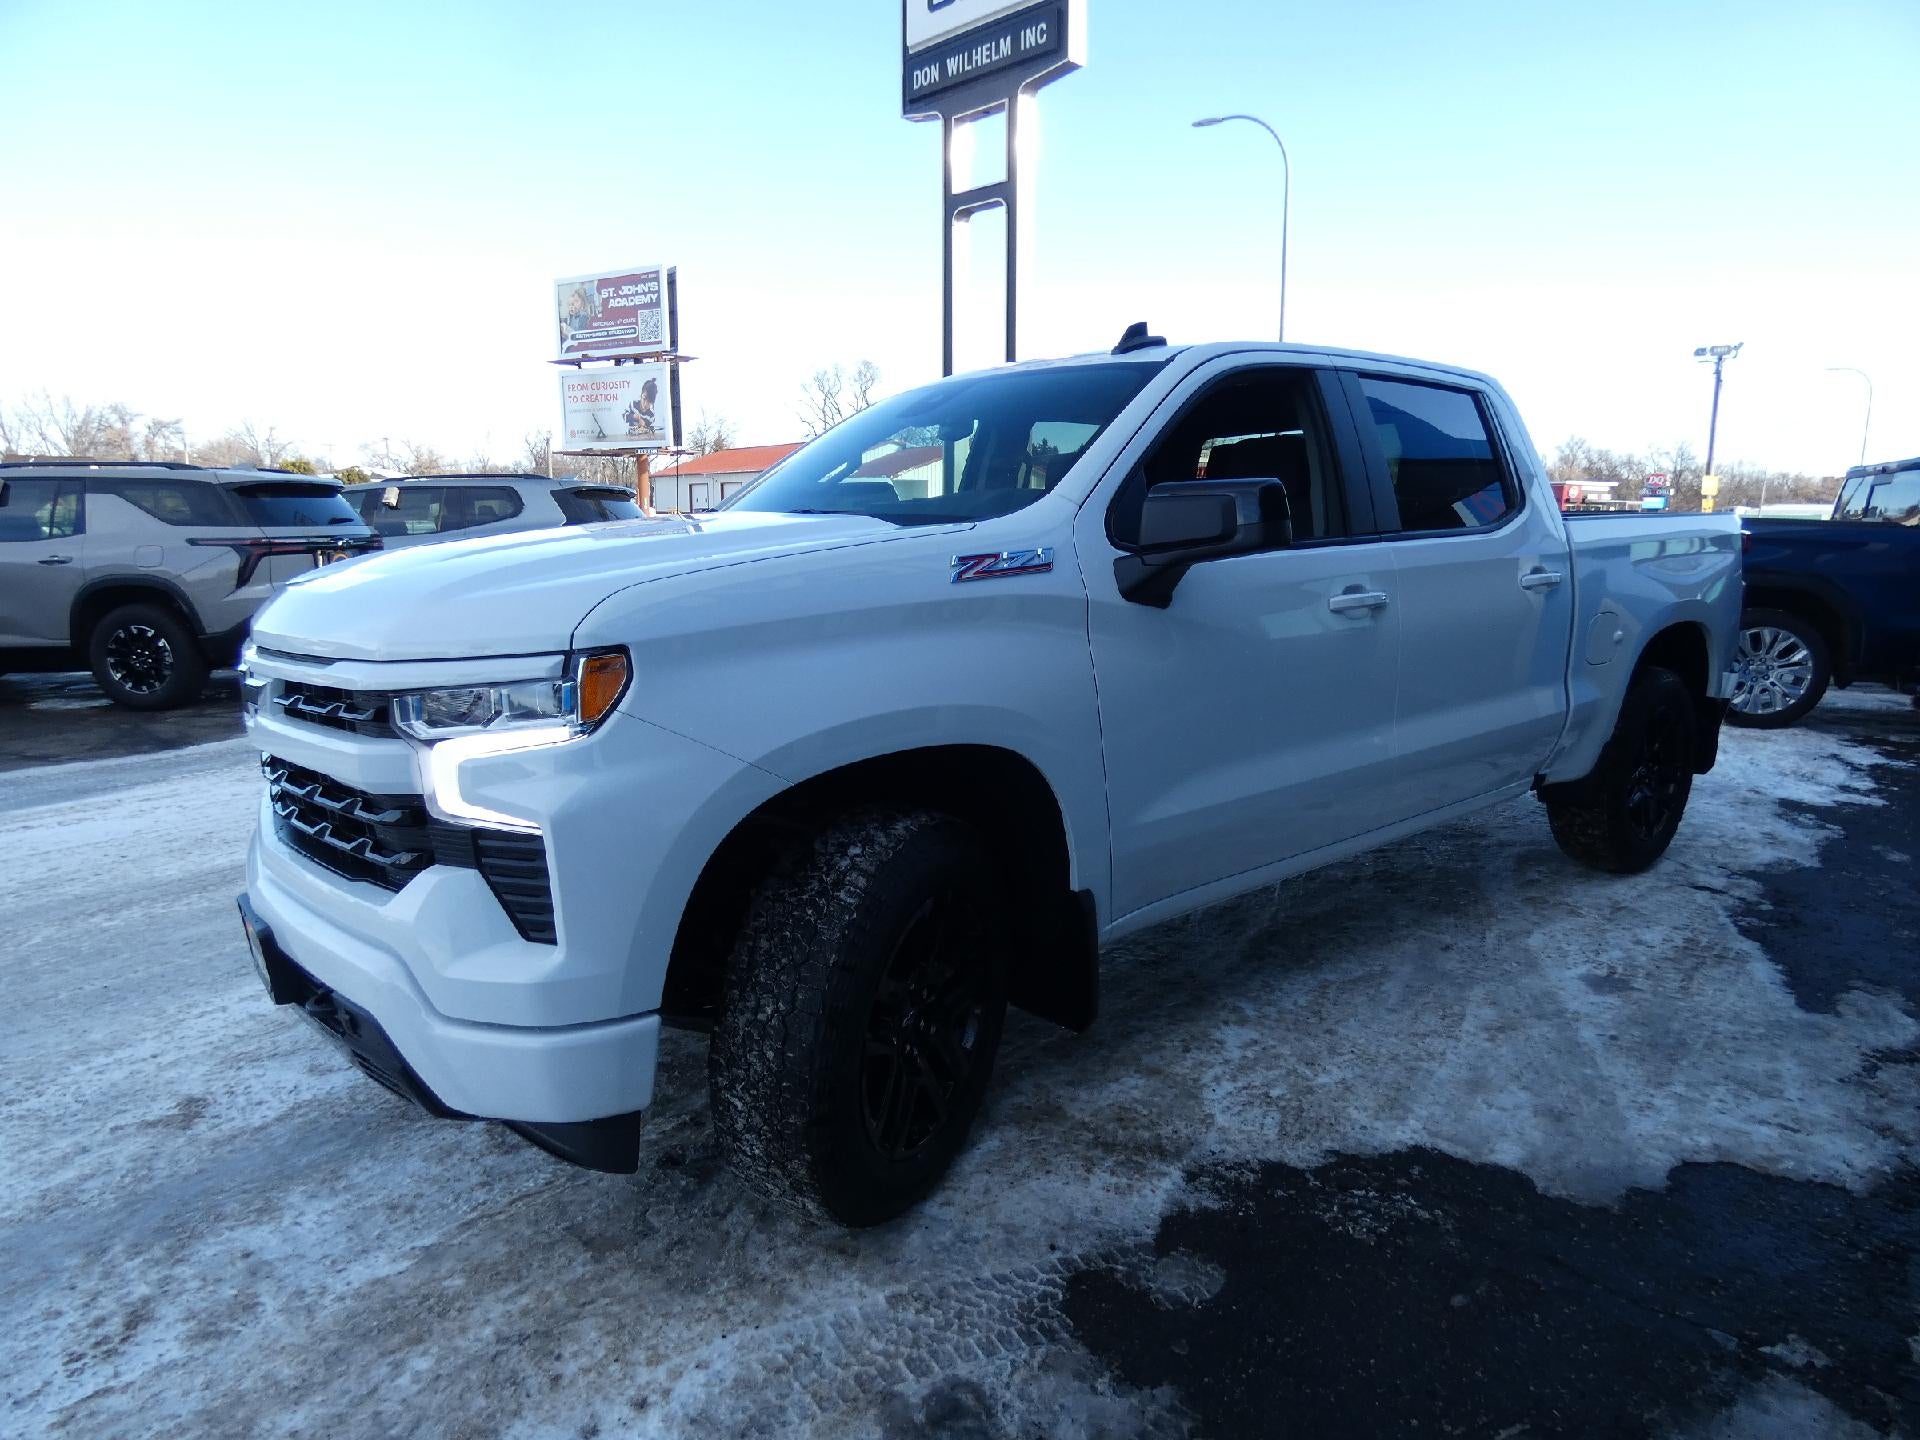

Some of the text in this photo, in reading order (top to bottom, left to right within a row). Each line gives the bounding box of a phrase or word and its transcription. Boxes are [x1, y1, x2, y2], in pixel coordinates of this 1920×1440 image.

[913, 22, 1048, 91] DON WILHELM INC
[601, 281, 659, 299] ST. JOHN'S
[608, 293, 658, 309] ACADEMY
[567, 380, 631, 392] FROM CURIOSITY
[568, 393, 618, 404] TO CREATION
[1649, 475, 1664, 486] DQ
